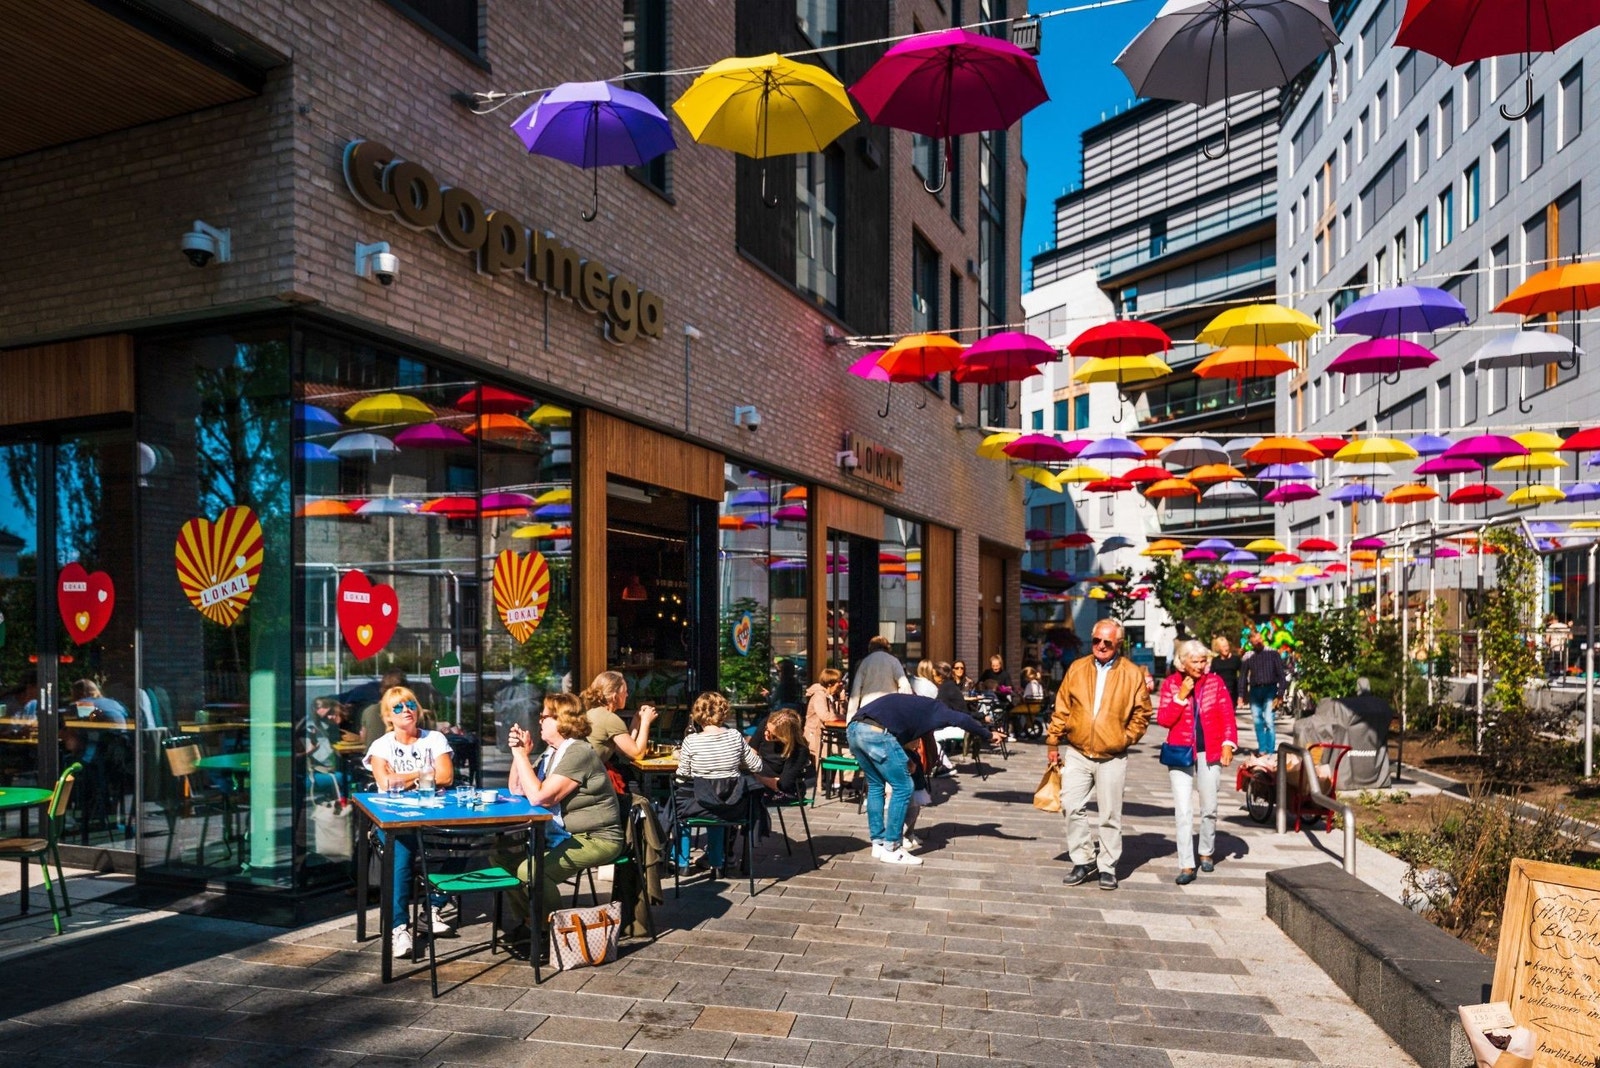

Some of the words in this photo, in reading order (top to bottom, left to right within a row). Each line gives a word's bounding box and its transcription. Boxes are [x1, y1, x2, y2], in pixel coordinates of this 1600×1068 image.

[856, 442, 902, 486] LOKAL
[64, 582, 87, 591] LOKAL
[203, 577, 247, 604] LOKAL
[345, 592, 369, 602] LOKAL
[508, 608, 538, 622] LOKAL
[440, 666, 460, 676] LOKAL
[1532, 960, 1575, 982] kanskje
[1527, 996, 1580, 1014] velkommen
